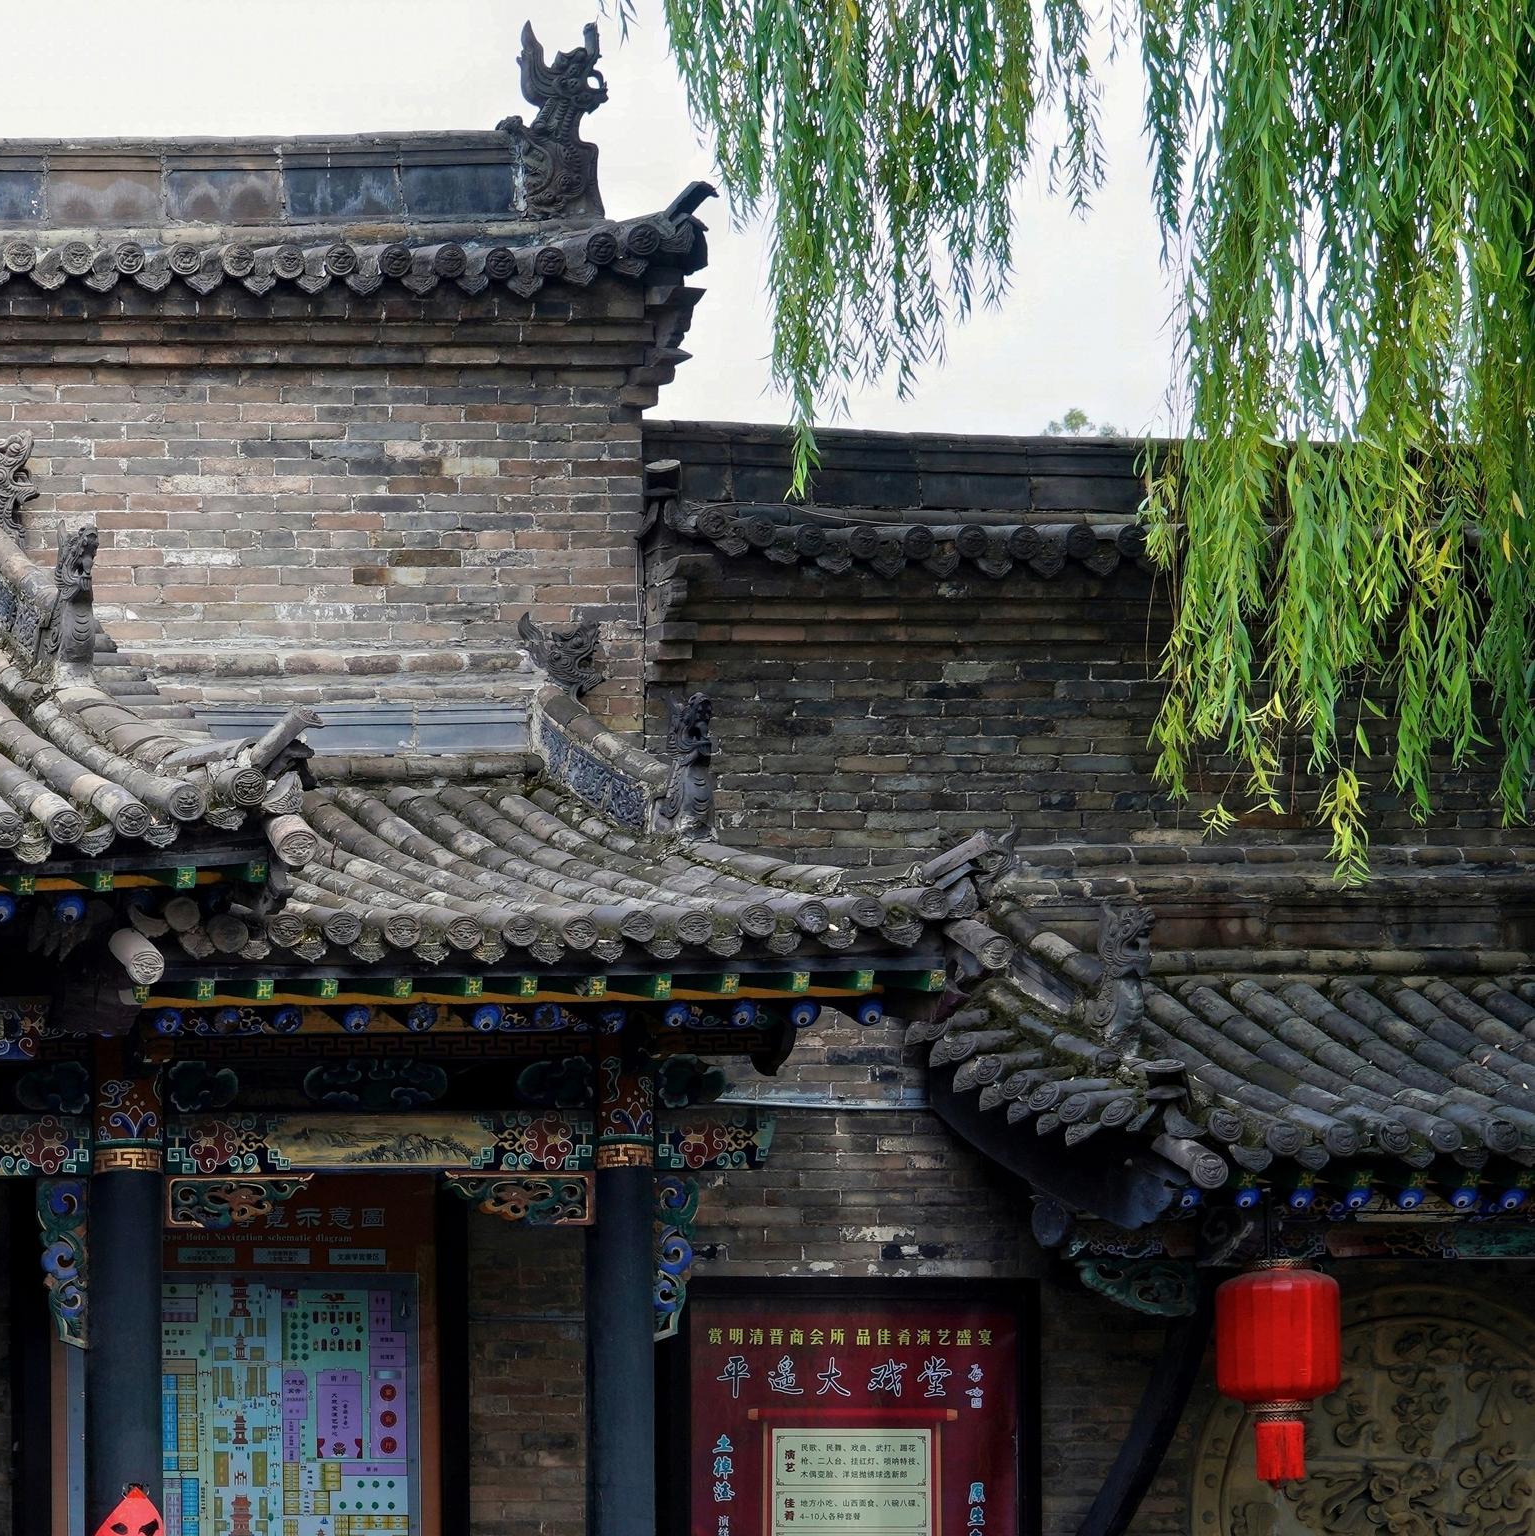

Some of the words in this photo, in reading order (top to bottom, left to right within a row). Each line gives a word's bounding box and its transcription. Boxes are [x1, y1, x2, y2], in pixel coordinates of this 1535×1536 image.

[186, 1233, 210, 1242] Hotel
[267, 1233, 312, 1242] schematic
[315, 1233, 353, 1244] diagram
[708, 1327, 846, 1347] 赏明清晋商会所
[855, 1327, 994, 1347] 品佳肴演艺盛宴
